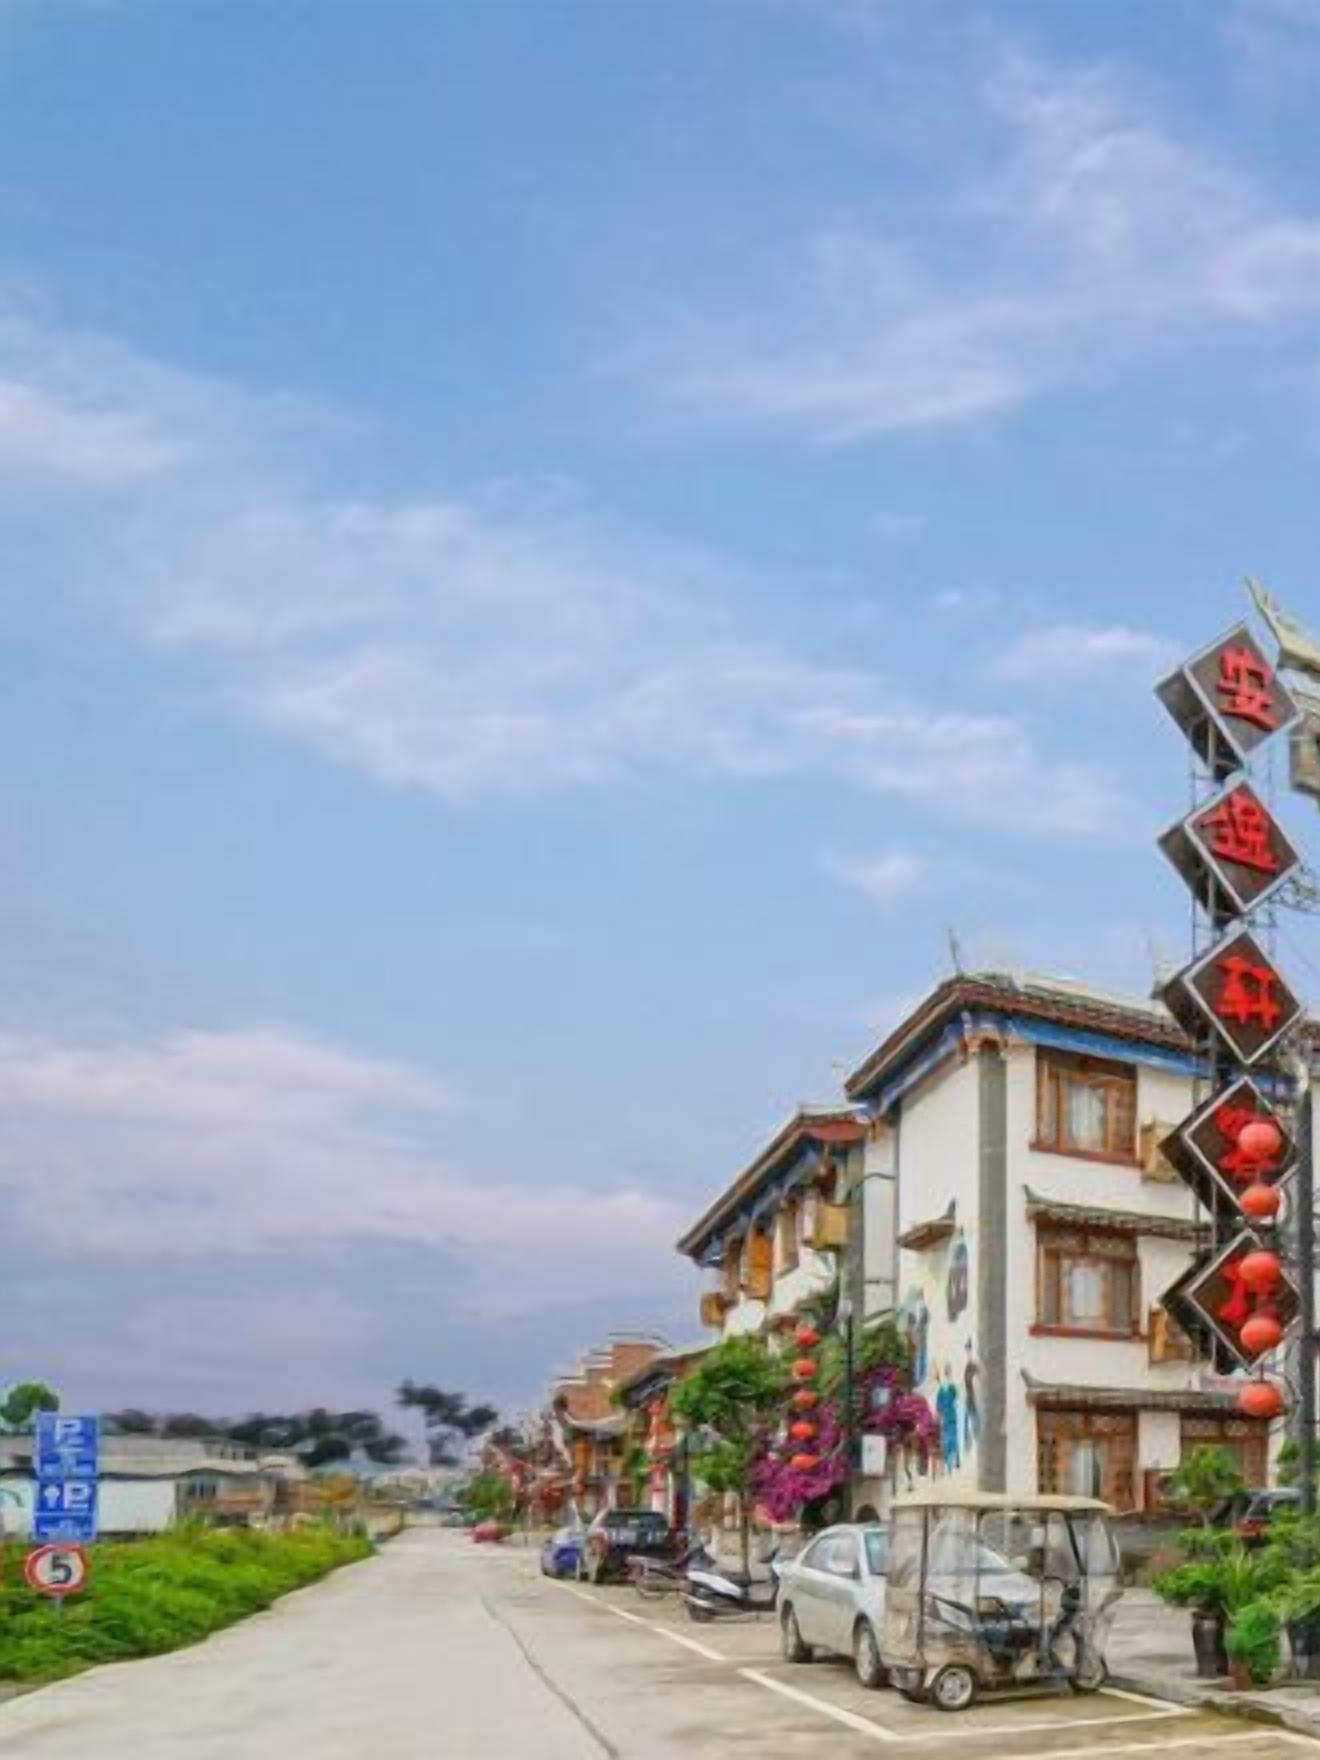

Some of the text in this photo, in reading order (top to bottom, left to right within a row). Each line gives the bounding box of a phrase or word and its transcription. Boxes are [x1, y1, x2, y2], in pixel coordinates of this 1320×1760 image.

[54, 1418, 83, 1448] P
[63, 1483, 91, 1510] P
[50, 1554, 73, 1585] 5
